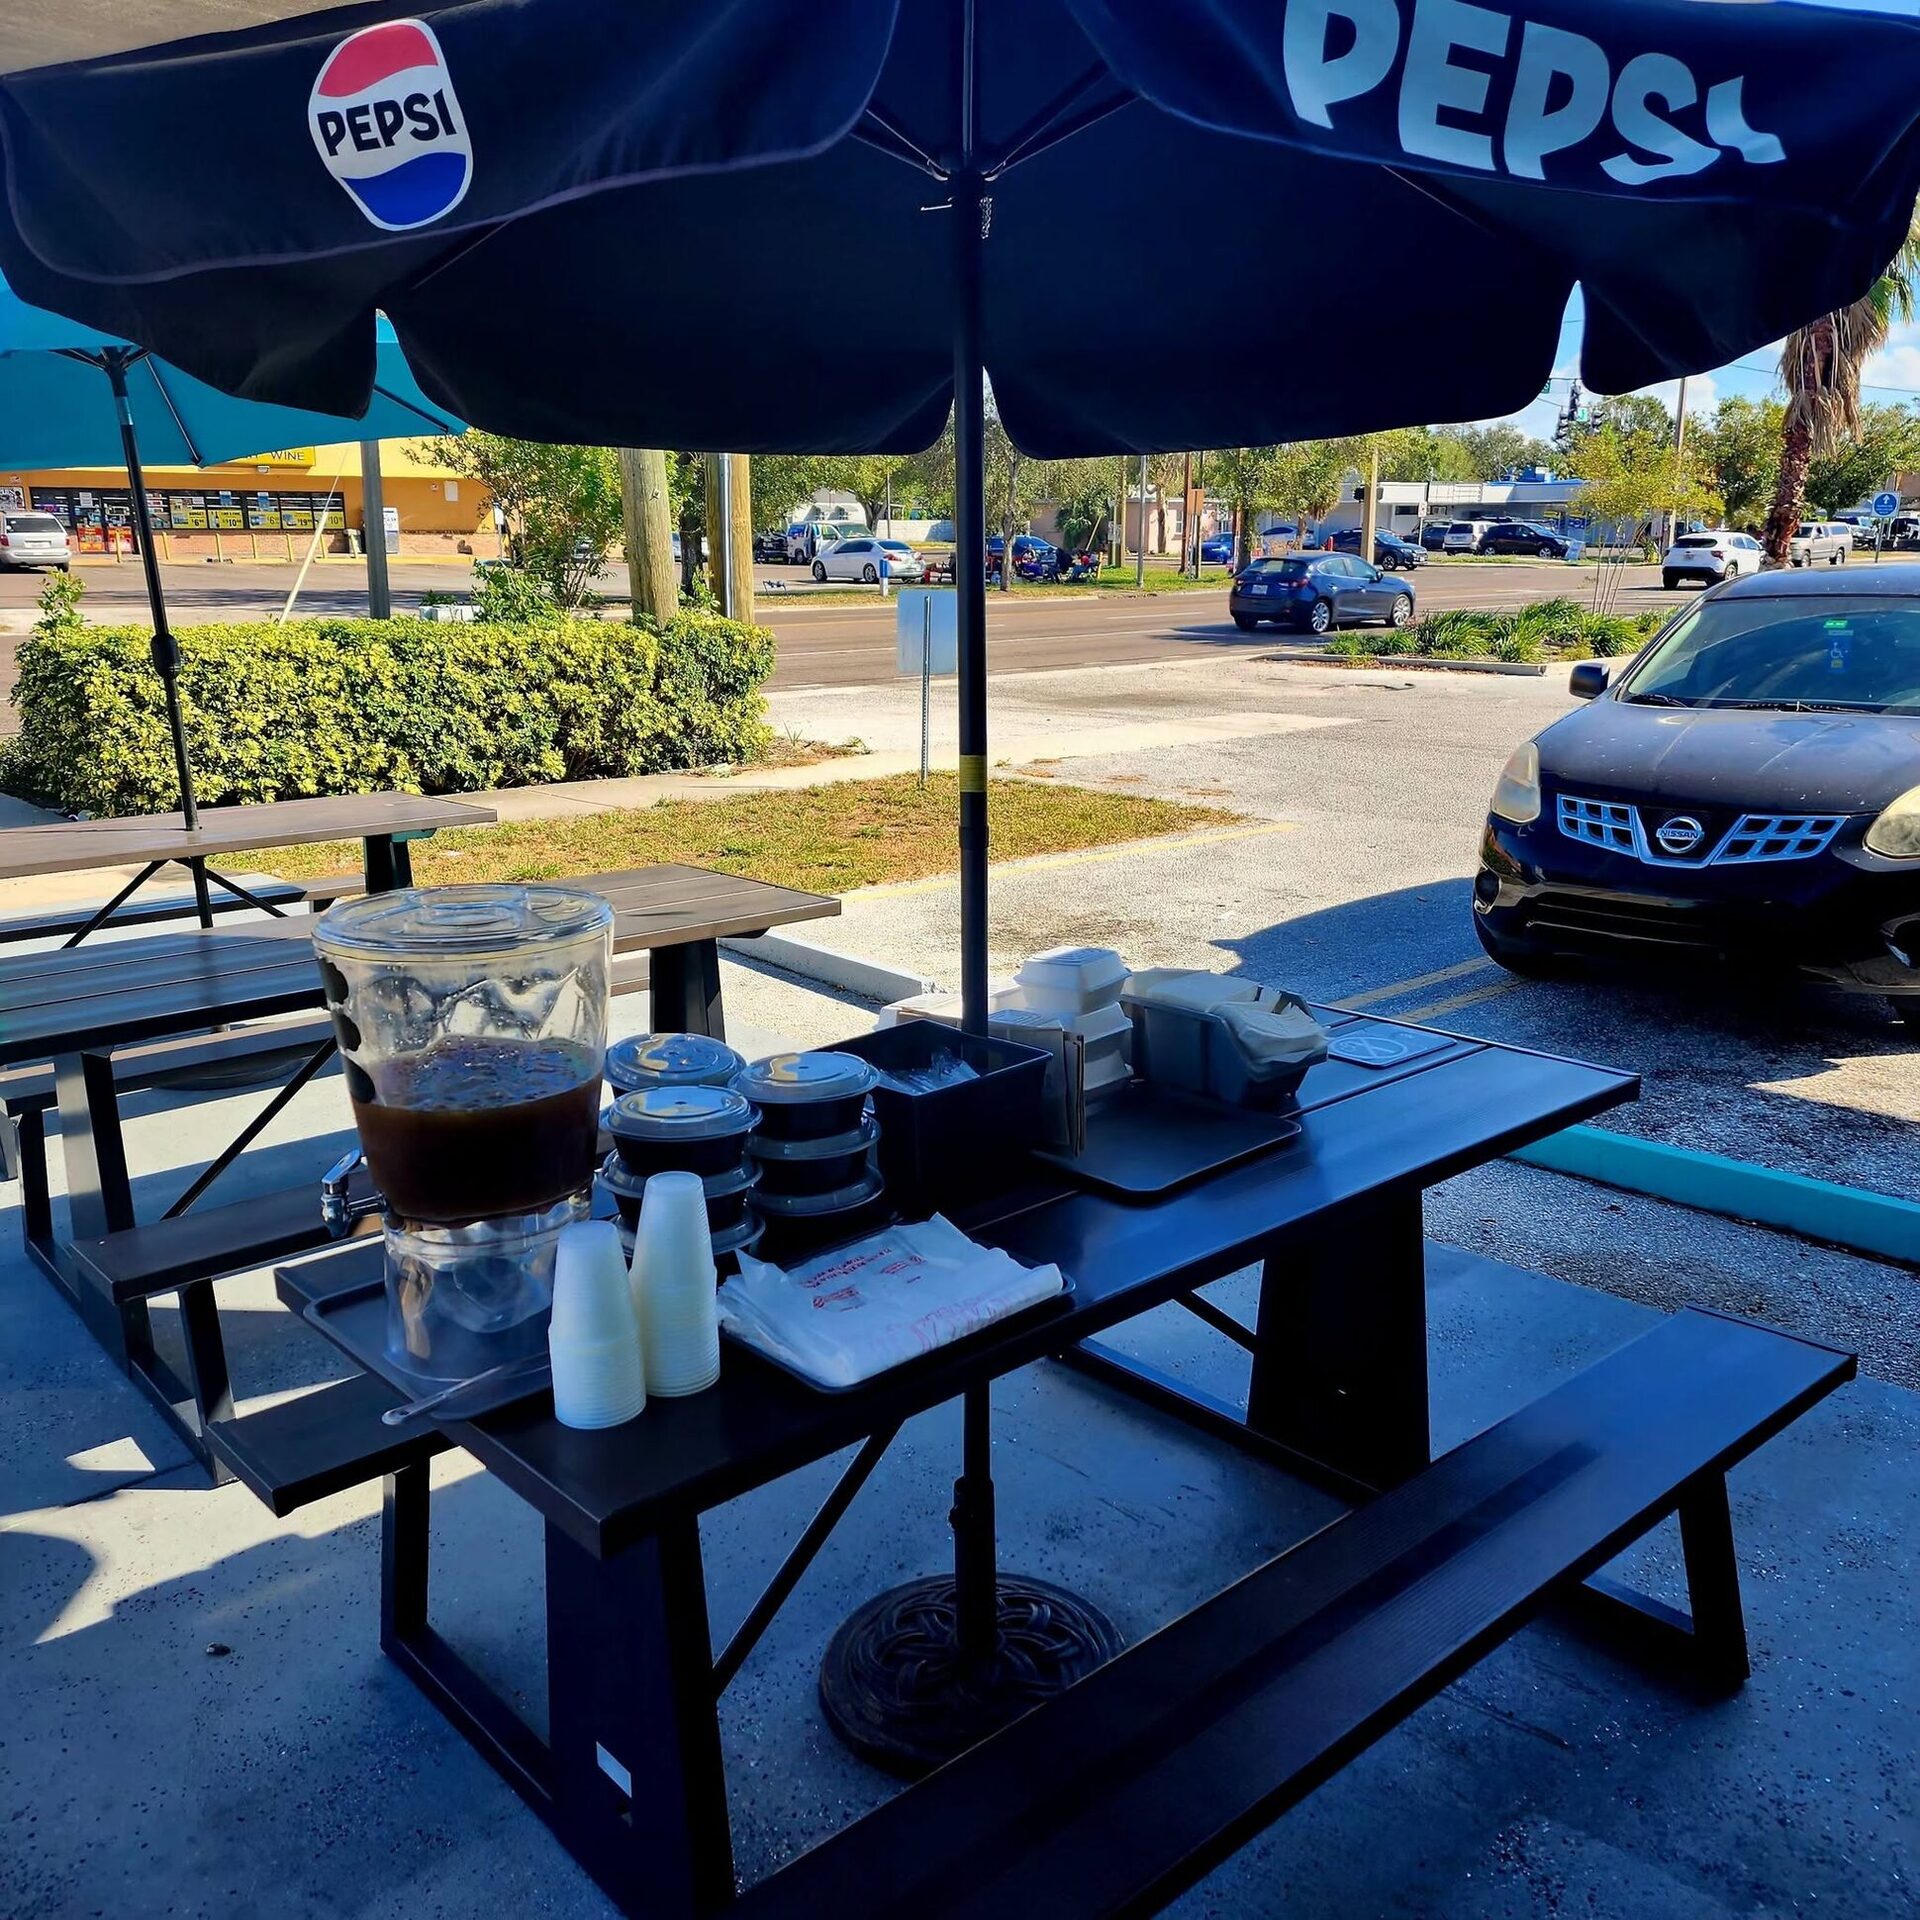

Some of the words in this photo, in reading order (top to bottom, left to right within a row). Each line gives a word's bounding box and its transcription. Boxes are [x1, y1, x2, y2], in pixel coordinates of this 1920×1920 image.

[1283, 0, 1787, 185] PEPSI
[317, 88, 457, 156] PEPSI
[271, 451, 305, 461] WINE
[1660, 829, 1699, 839] NISSAN
